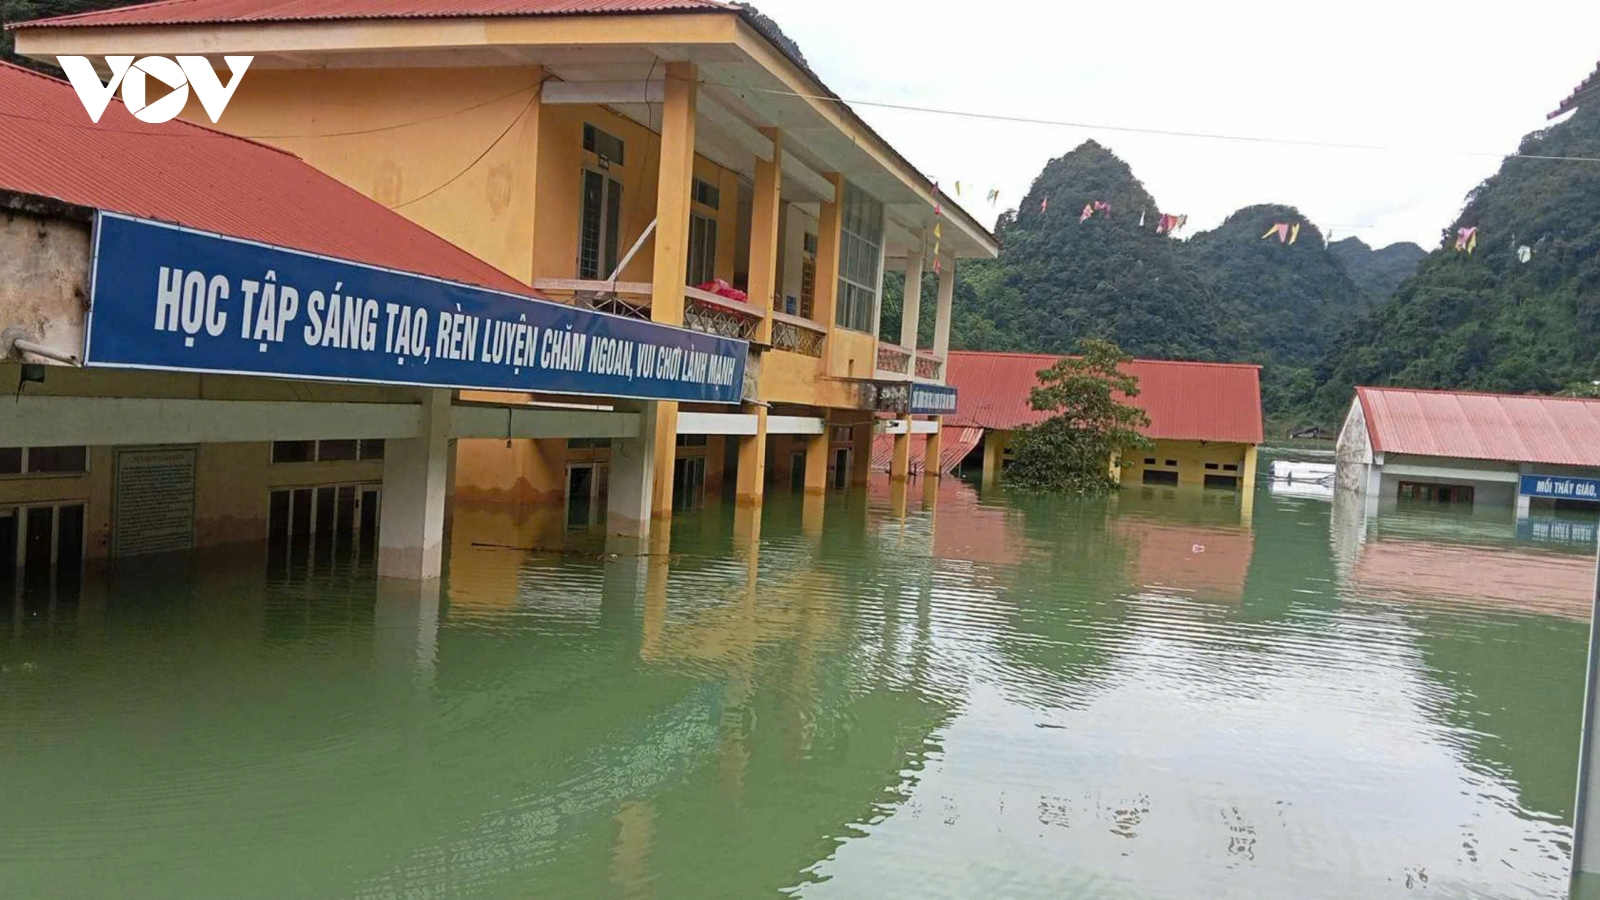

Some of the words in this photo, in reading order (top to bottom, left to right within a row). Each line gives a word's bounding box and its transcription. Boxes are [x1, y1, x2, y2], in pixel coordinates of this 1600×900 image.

[154, 266, 229, 347] HỌC
[241, 270, 299, 352] TẬP
[304, 282, 379, 351] SÁNG
[385, 303, 430, 365] TẠO,
[435, 303, 479, 361] RÈN
[481, 314, 539, 375] LUYỆN
[540, 324, 586, 372] CHĂM
[588, 336, 634, 382] NGOAN,
[636, 343, 656, 378] VUI
[656, 346, 682, 381] CHƠI
[681, 344, 708, 384] LÀNH
[707, 354, 736, 391] MẠNH
